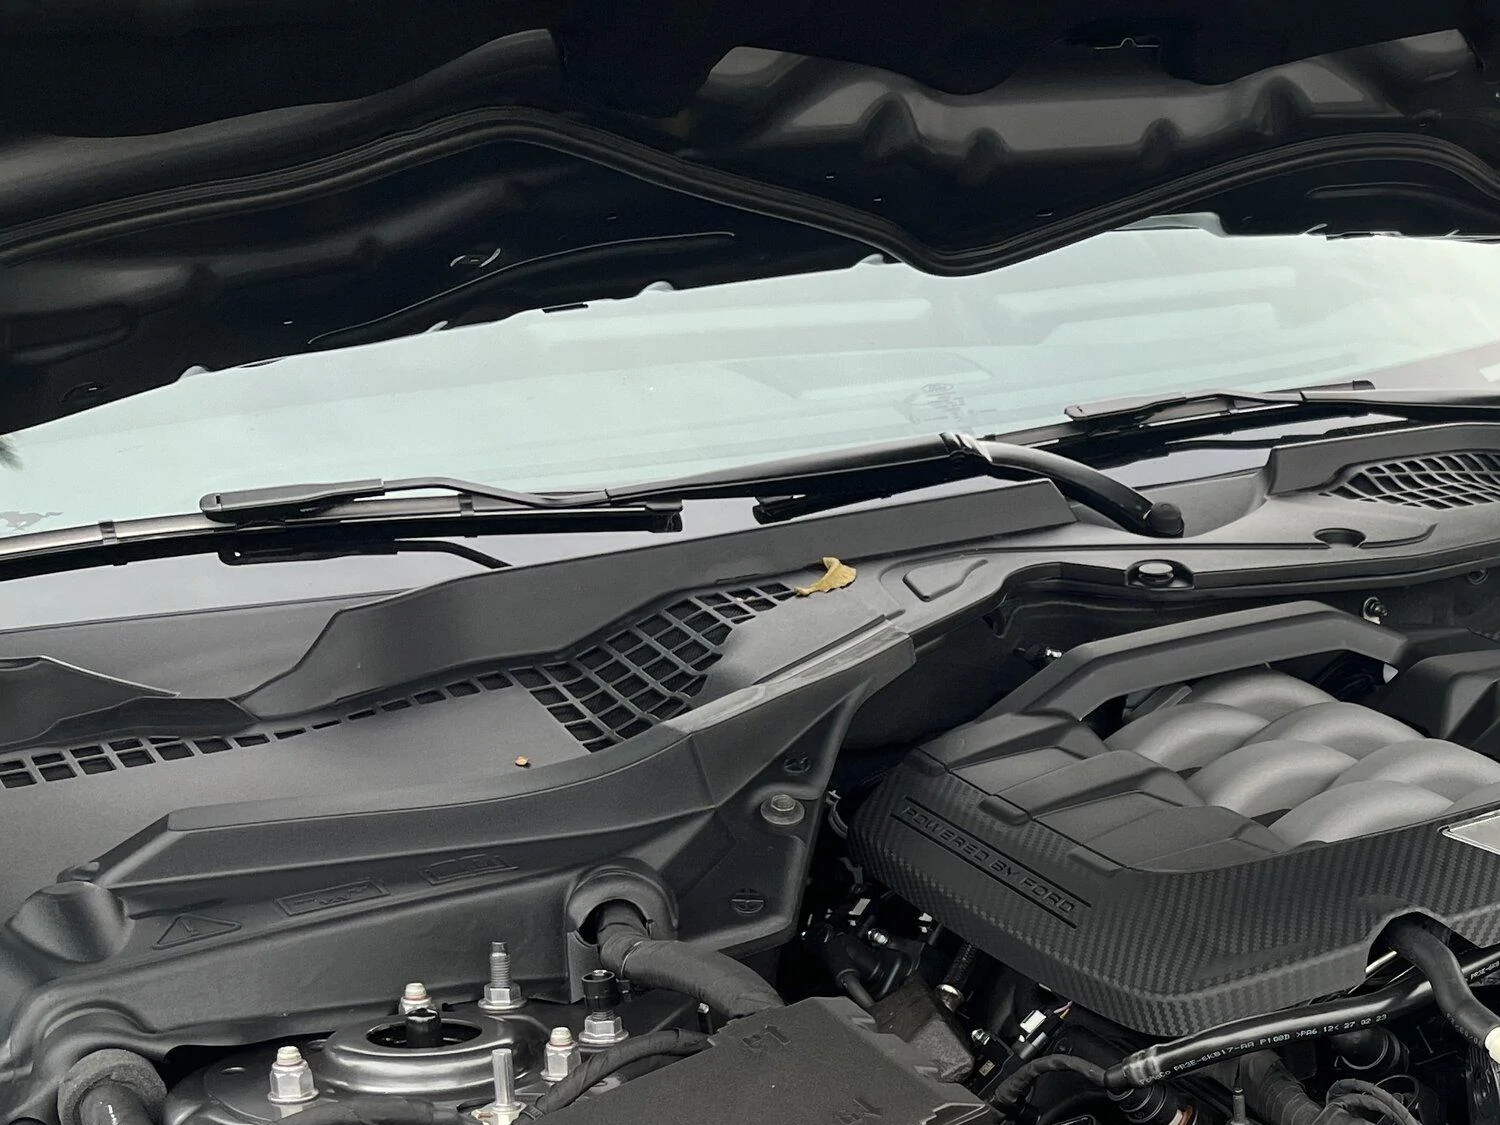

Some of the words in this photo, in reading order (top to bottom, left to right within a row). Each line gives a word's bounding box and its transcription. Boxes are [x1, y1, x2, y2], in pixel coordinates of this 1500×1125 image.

[902, 807, 990, 863] POWERED
[989, 858, 1020, 877] BY
[1020, 876, 1075, 914] FORD
